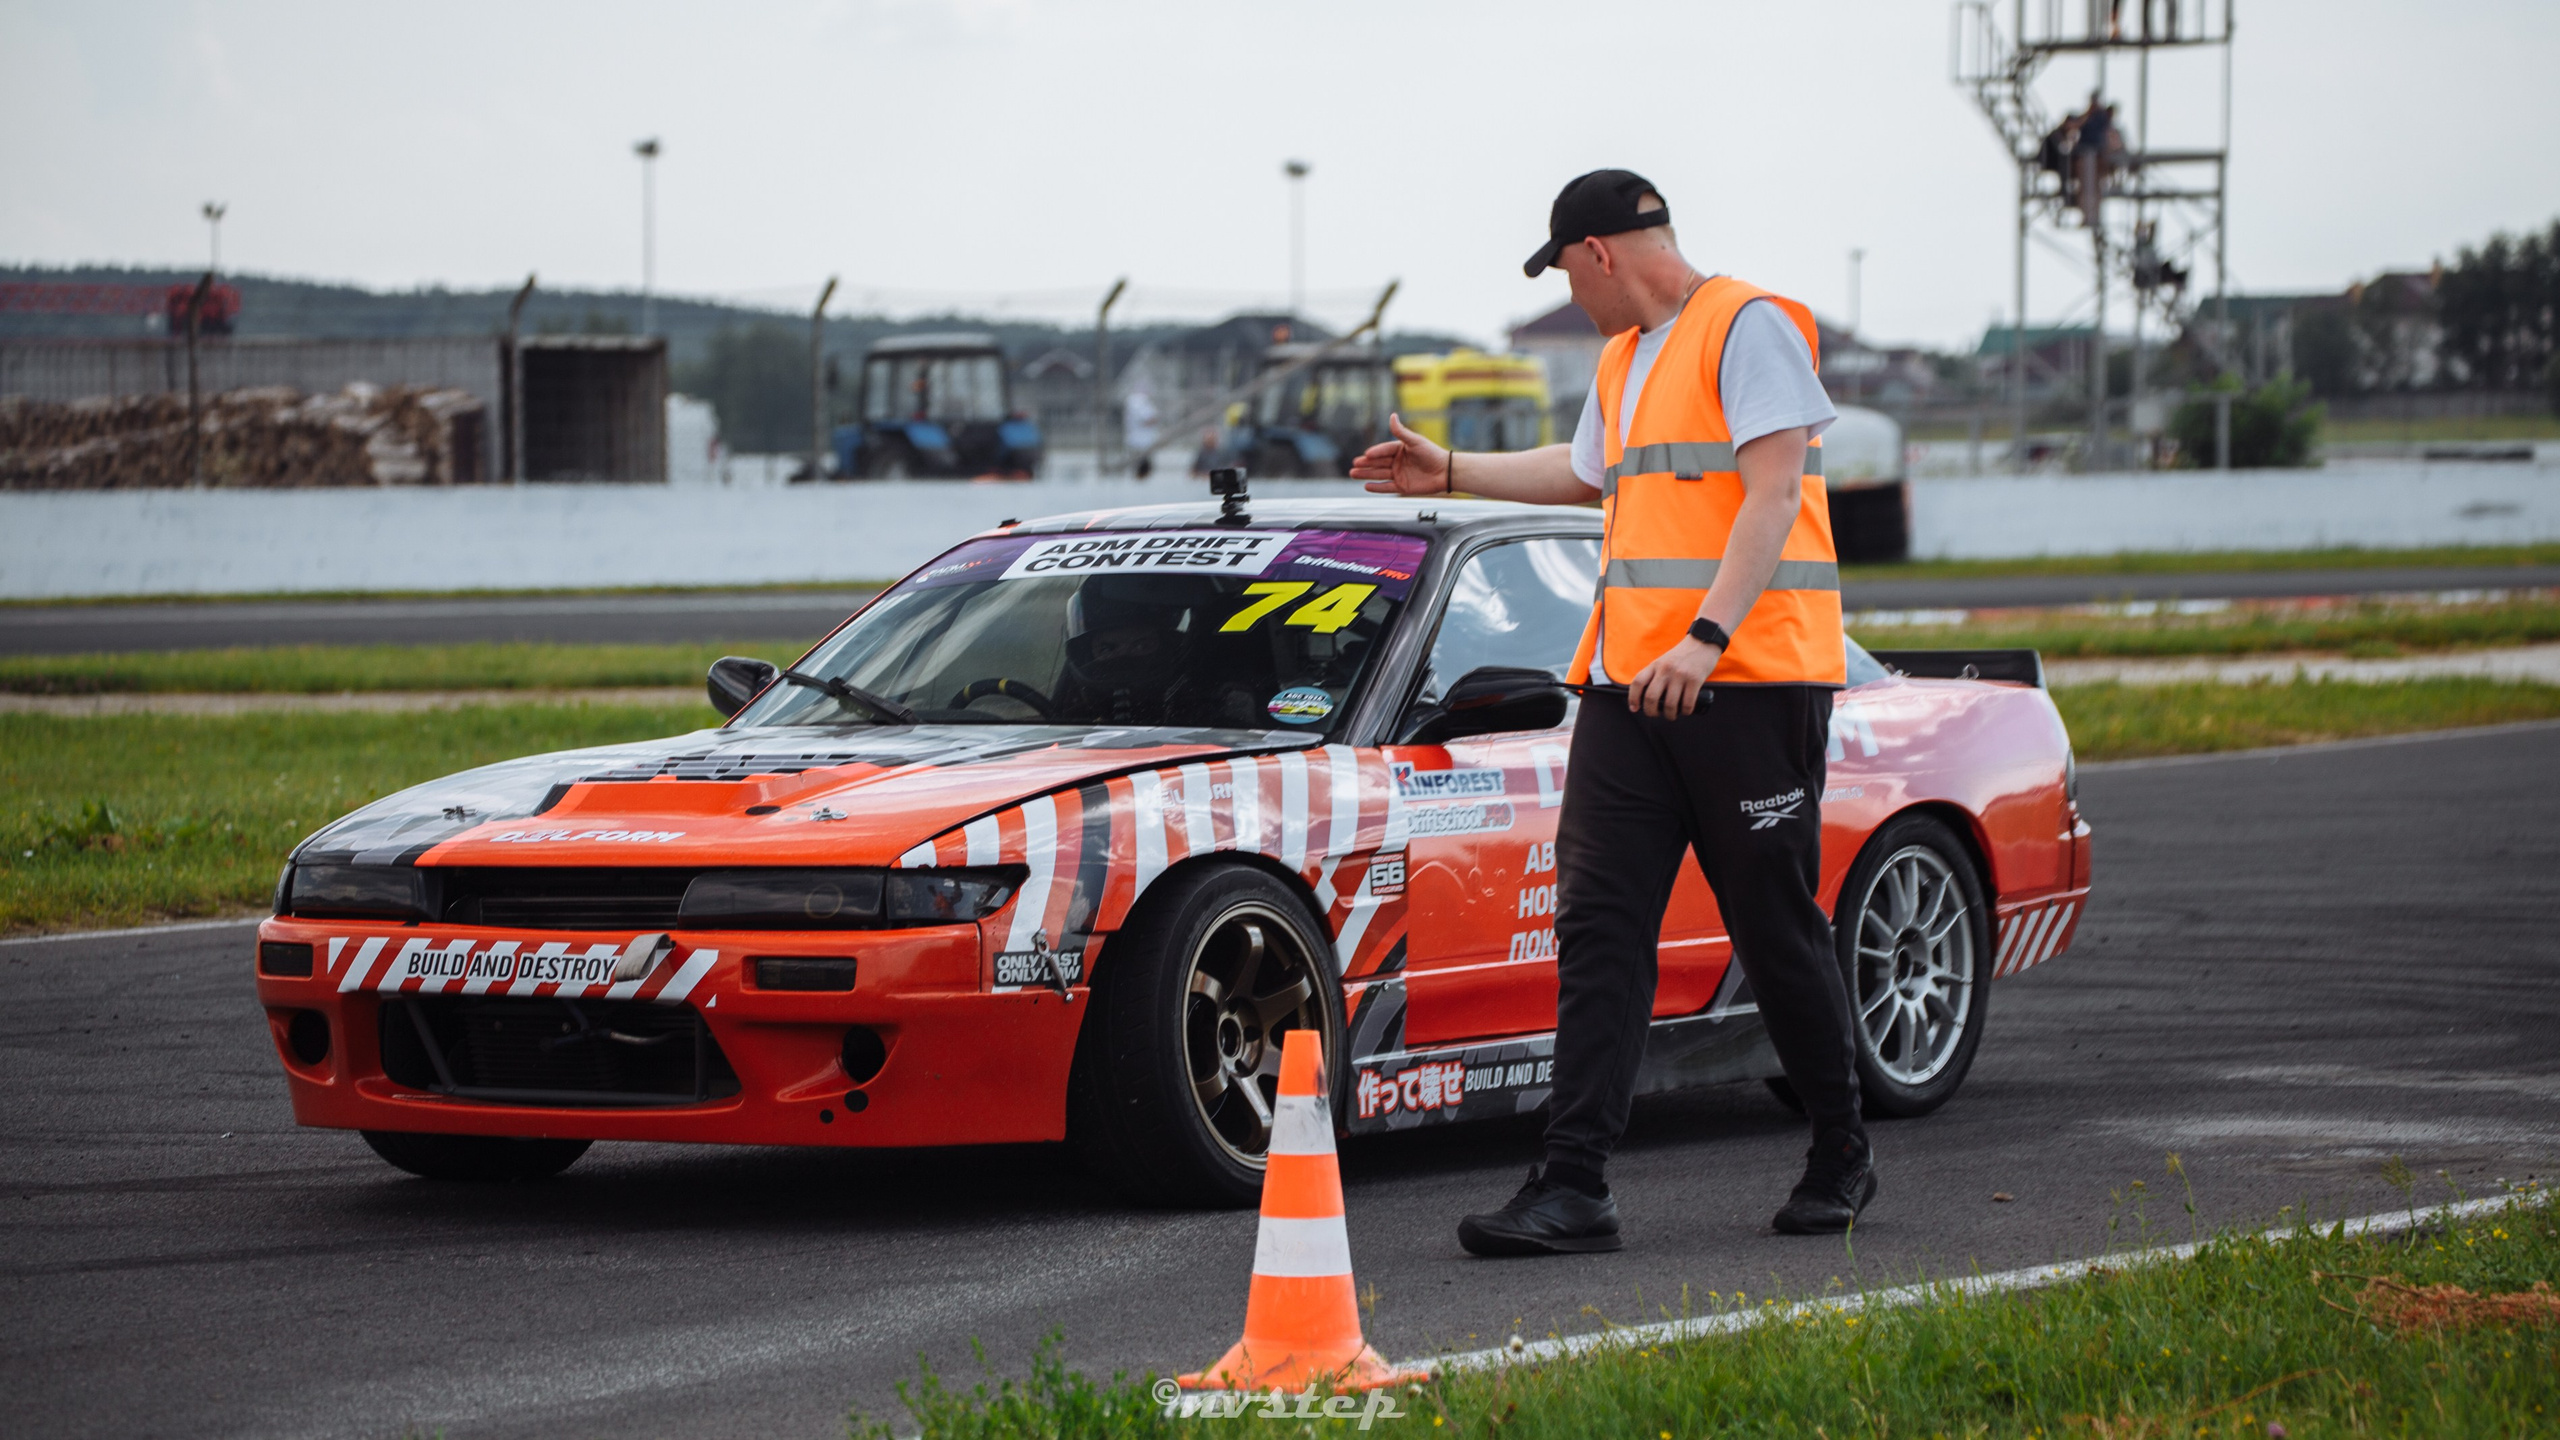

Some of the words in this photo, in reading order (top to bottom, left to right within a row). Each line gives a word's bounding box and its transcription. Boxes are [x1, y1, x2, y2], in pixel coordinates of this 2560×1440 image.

[1024, 551, 1258, 571] CONTEST
[1037, 538, 1142, 556] ADM
[1142, 537, 1274, 550] DRIFT
[1217, 580, 1380, 634] 74
[1393, 766, 1503, 796] KINFOREST
[1740, 788, 1805, 813] Reebok
[1523, 842, 1557, 875] АВ
[1371, 860, 1405, 888] 56
[1508, 928, 1559, 963] ПОК
[407, 952, 466, 977] BUILD
[468, 954, 517, 978] AND
[518, 956, 617, 981] DESTROY
[997, 954, 1039, 970] ONLY
[998, 967, 1042, 983] ONLY
[1358, 1060, 1464, 1118] 作って壊せ
[1464, 1066, 1503, 1092] BUILD
[1505, 1064, 1532, 1087] AND
[1536, 1060, 1554, 1083] DE
